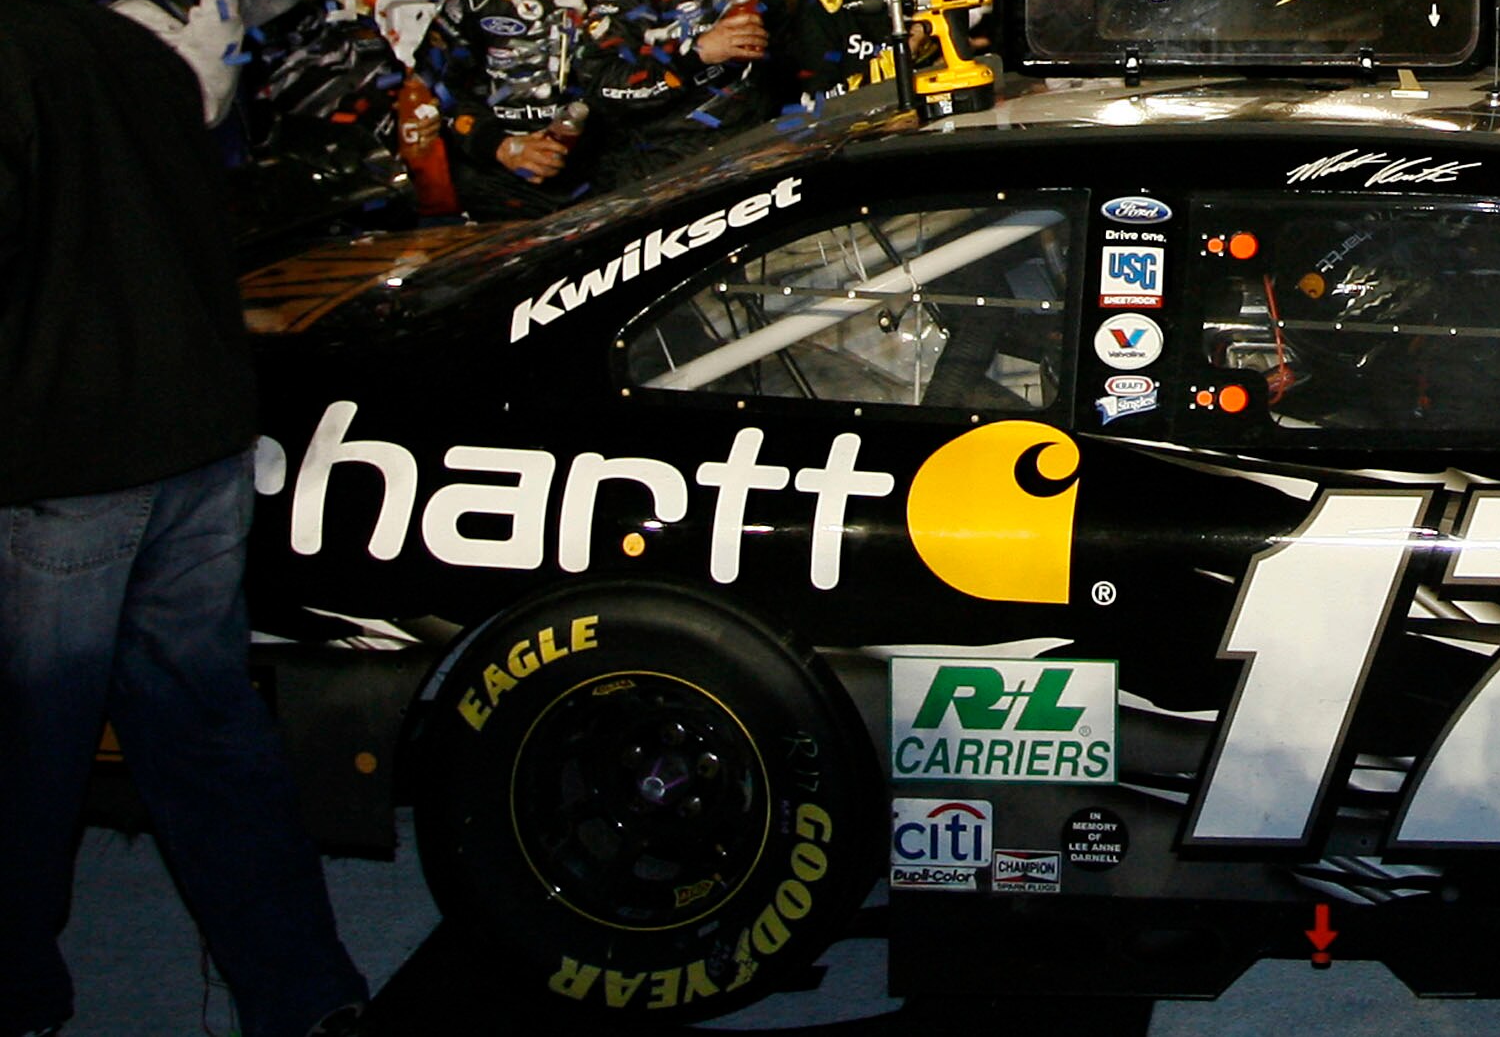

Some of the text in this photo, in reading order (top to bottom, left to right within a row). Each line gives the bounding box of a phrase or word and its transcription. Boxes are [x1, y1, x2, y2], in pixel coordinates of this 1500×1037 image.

[1115, 199, 1160, 218] Ford
[1105, 229, 1167, 243] Drive one.
[510, 176, 803, 343] Kwikset
[1108, 252, 1158, 291] USG
[1107, 350, 1147, 359] Valvoline
[1115, 381, 1145, 390] KRAFT
[254, 400, 895, 589] hartt
[457, 614, 599, 731] EAGLE
[895, 736, 1112, 778] CARRIERS
[1089, 812, 1102, 821] IN
[1072, 822, 1118, 831] MEMORY
[893, 814, 984, 862] citi
[1088, 833, 1102, 841] OF
[1068, 843, 1122, 852] LEE ANNE
[1070, 853, 1120, 863] DARNELL
[998, 859, 1056, 875] CHAMPION
[893, 868, 975, 884] Dupli-Color
[997, 882, 1026, 892] SPARK
[549, 803, 833, 1010] GOODYEAR
